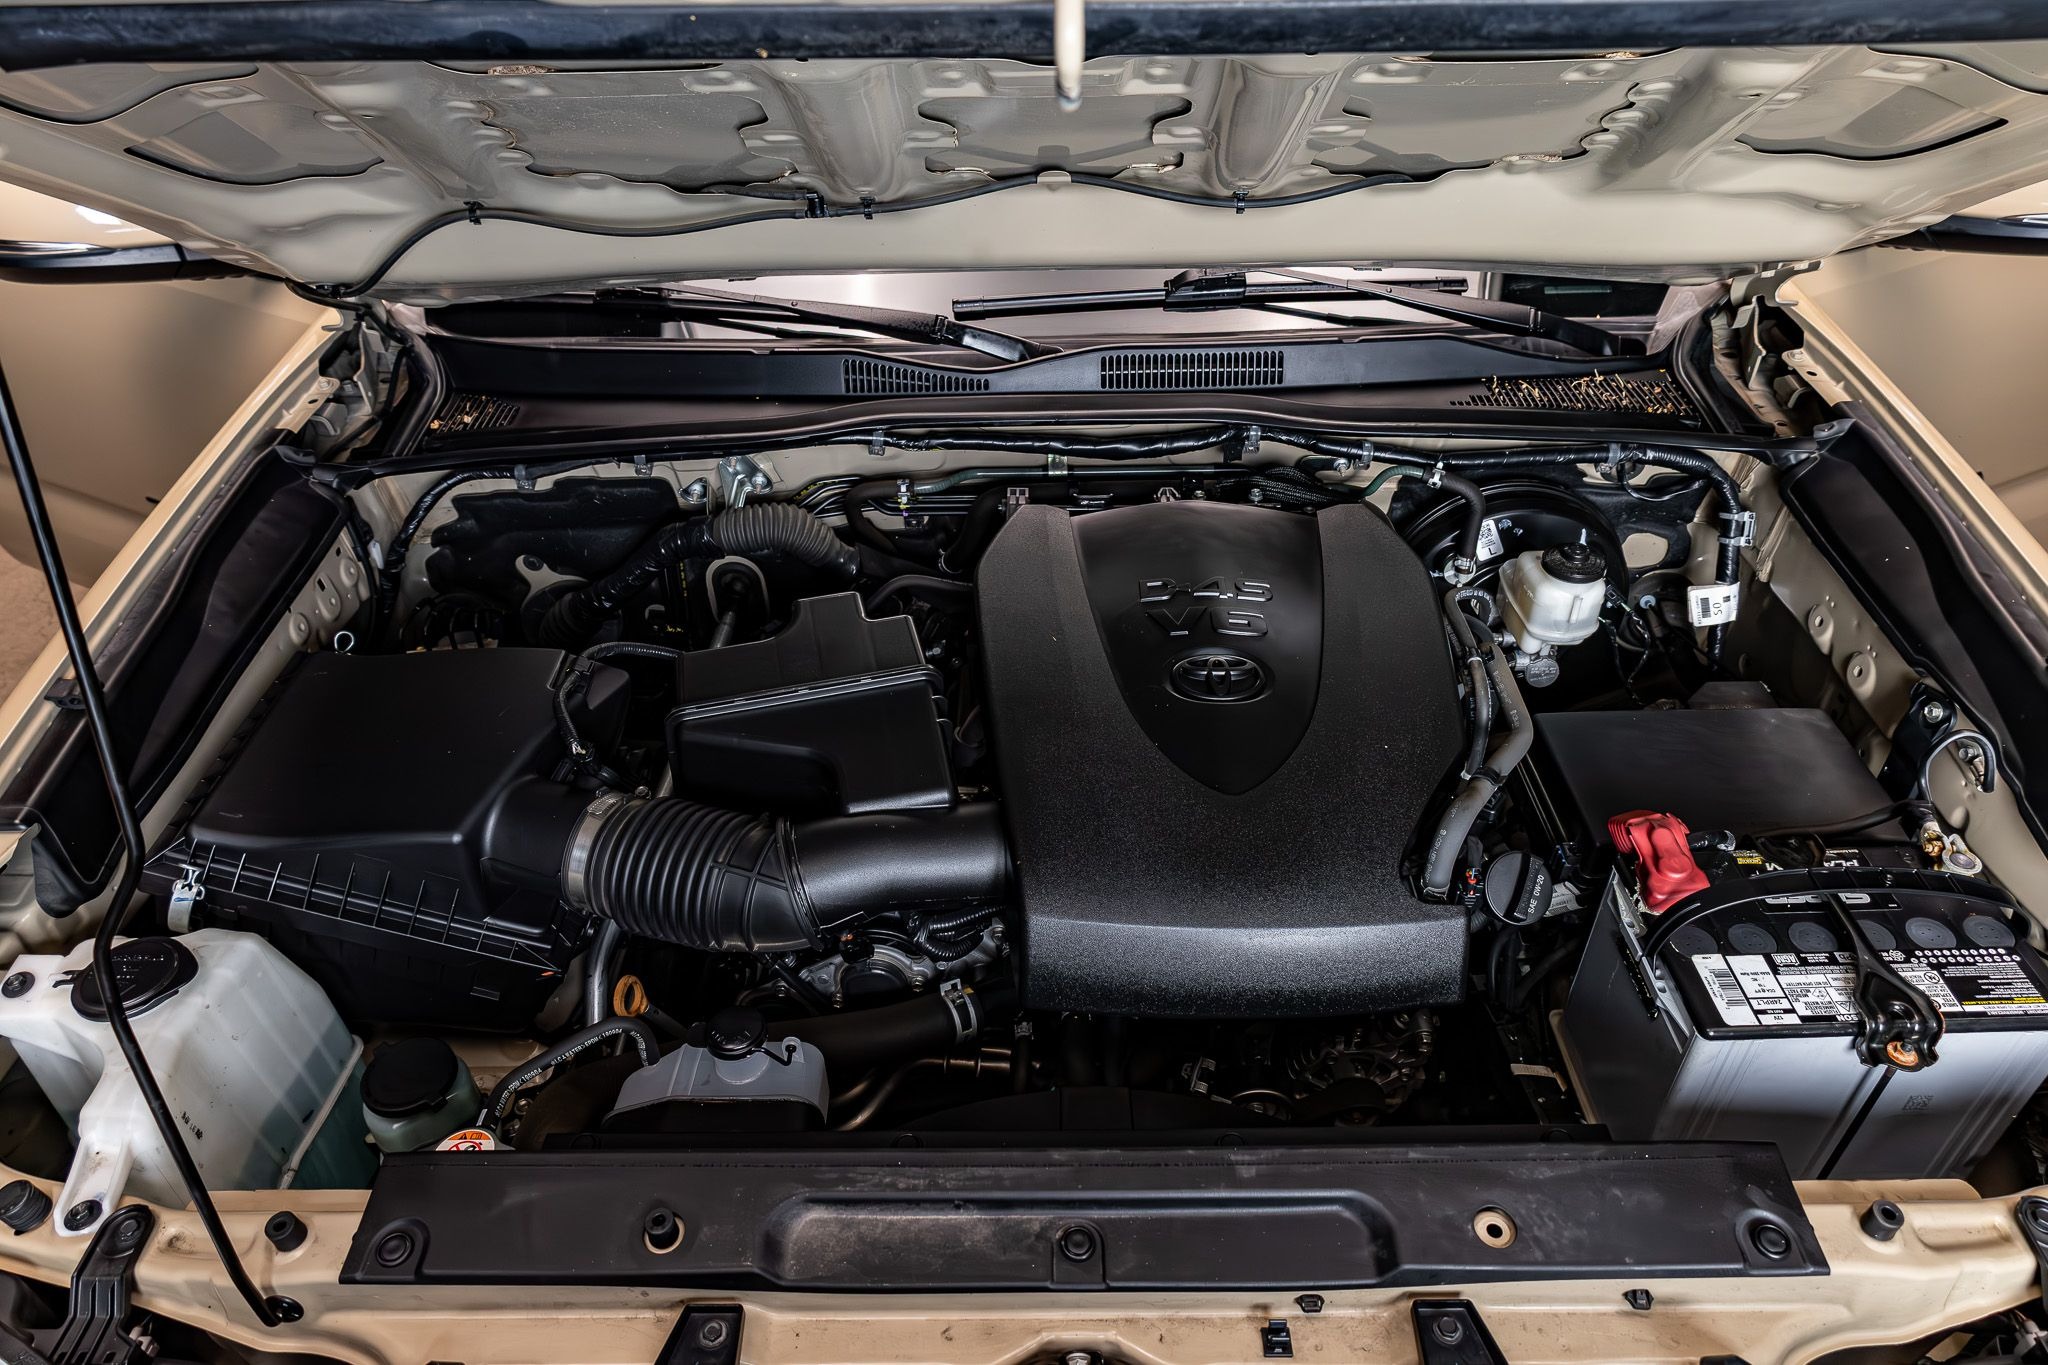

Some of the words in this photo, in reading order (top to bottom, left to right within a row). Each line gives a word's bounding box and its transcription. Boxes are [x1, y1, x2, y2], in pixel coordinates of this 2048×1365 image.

[1147, 606, 1268, 637] V6
[1528, 898, 1538, 914] SAE
[1534, 874, 1544, 896] 0W-20
